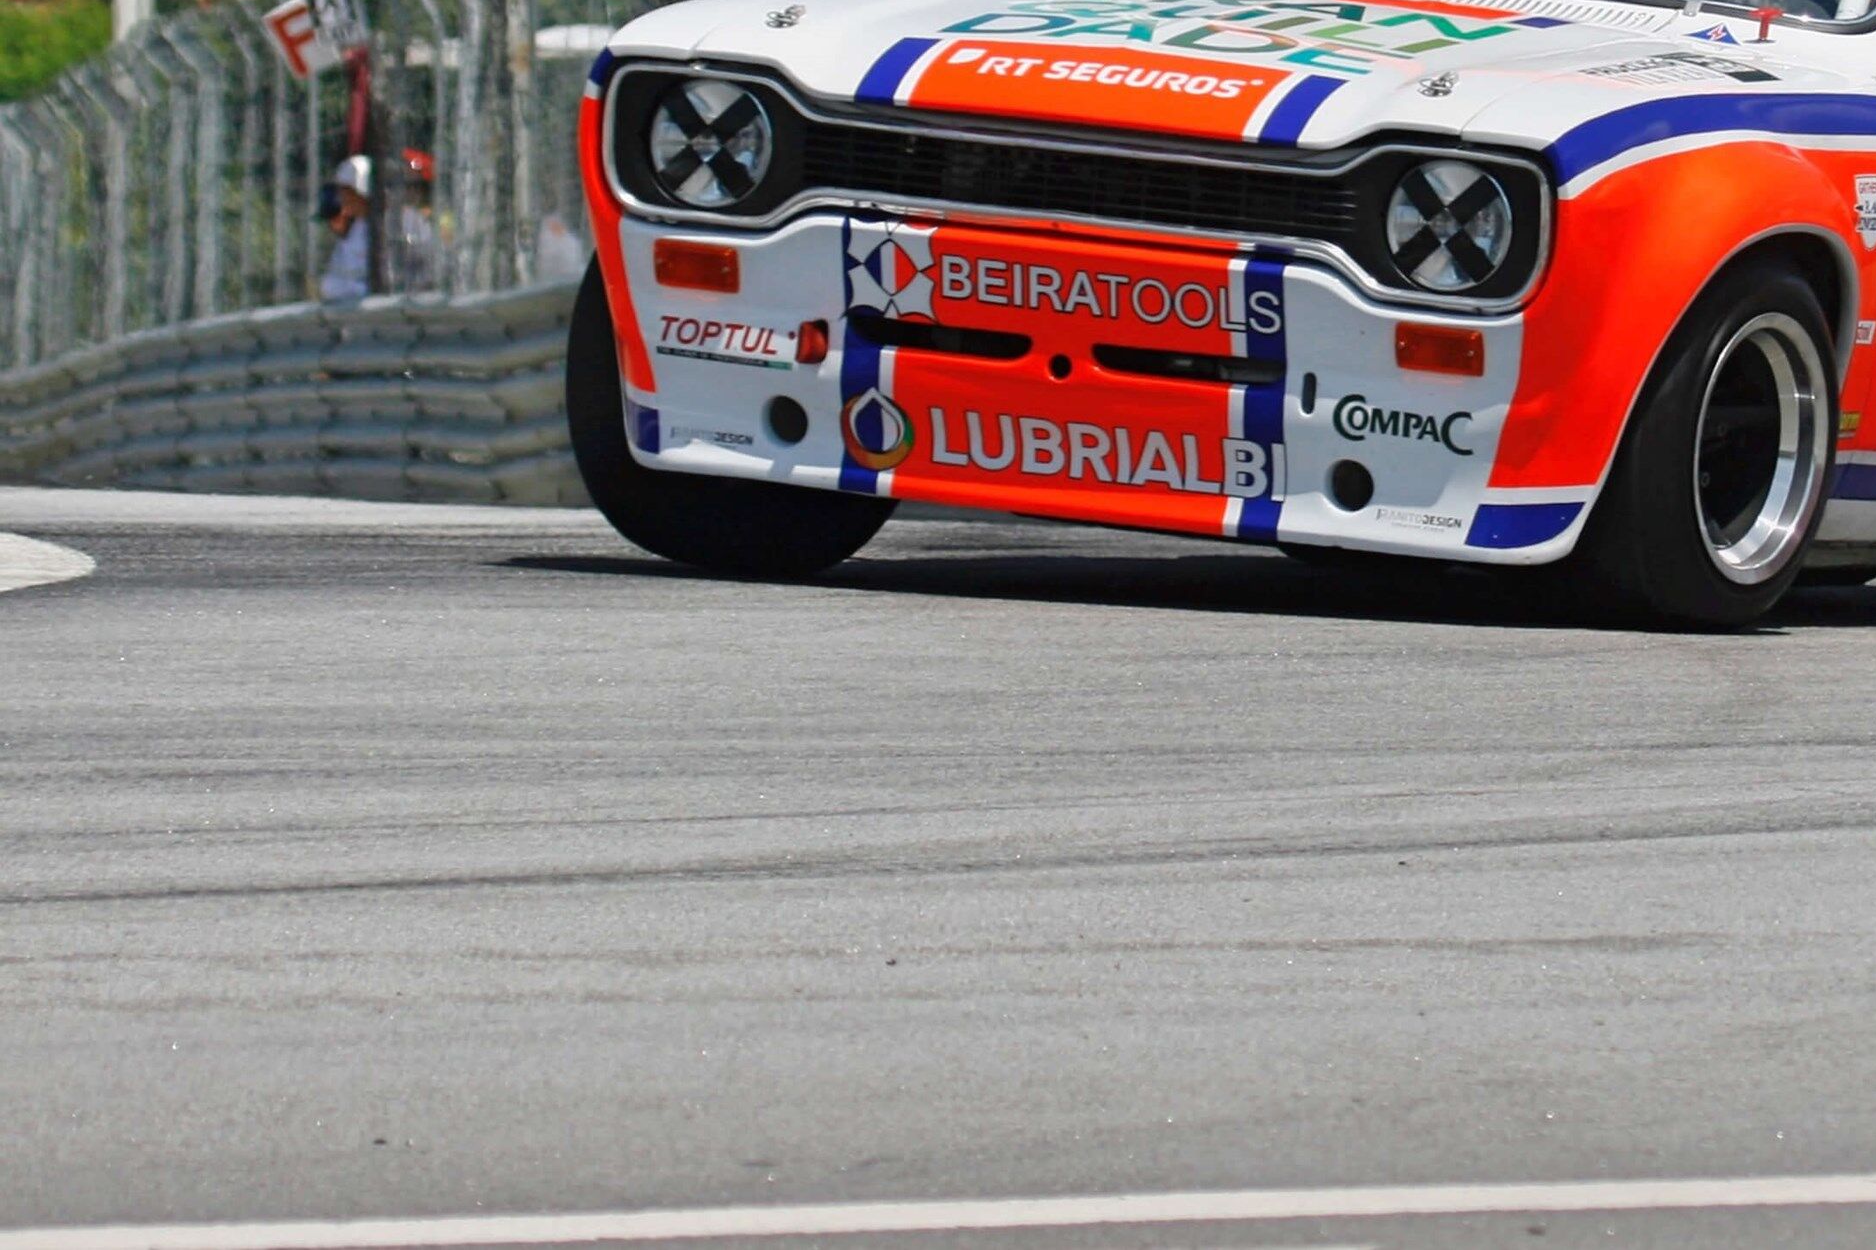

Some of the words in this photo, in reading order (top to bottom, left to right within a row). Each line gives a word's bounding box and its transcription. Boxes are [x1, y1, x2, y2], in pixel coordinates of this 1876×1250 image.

[977, 56, 1043, 77] RT
[1044, 61, 1247, 97] SEGUROS
[939, 254, 1282, 334] BEIRATOOLS
[660, 315, 778, 355] TOPTUL
[929, 407, 1288, 502] LUBRIALBI
[1333, 394, 1474, 456] COMPAC
